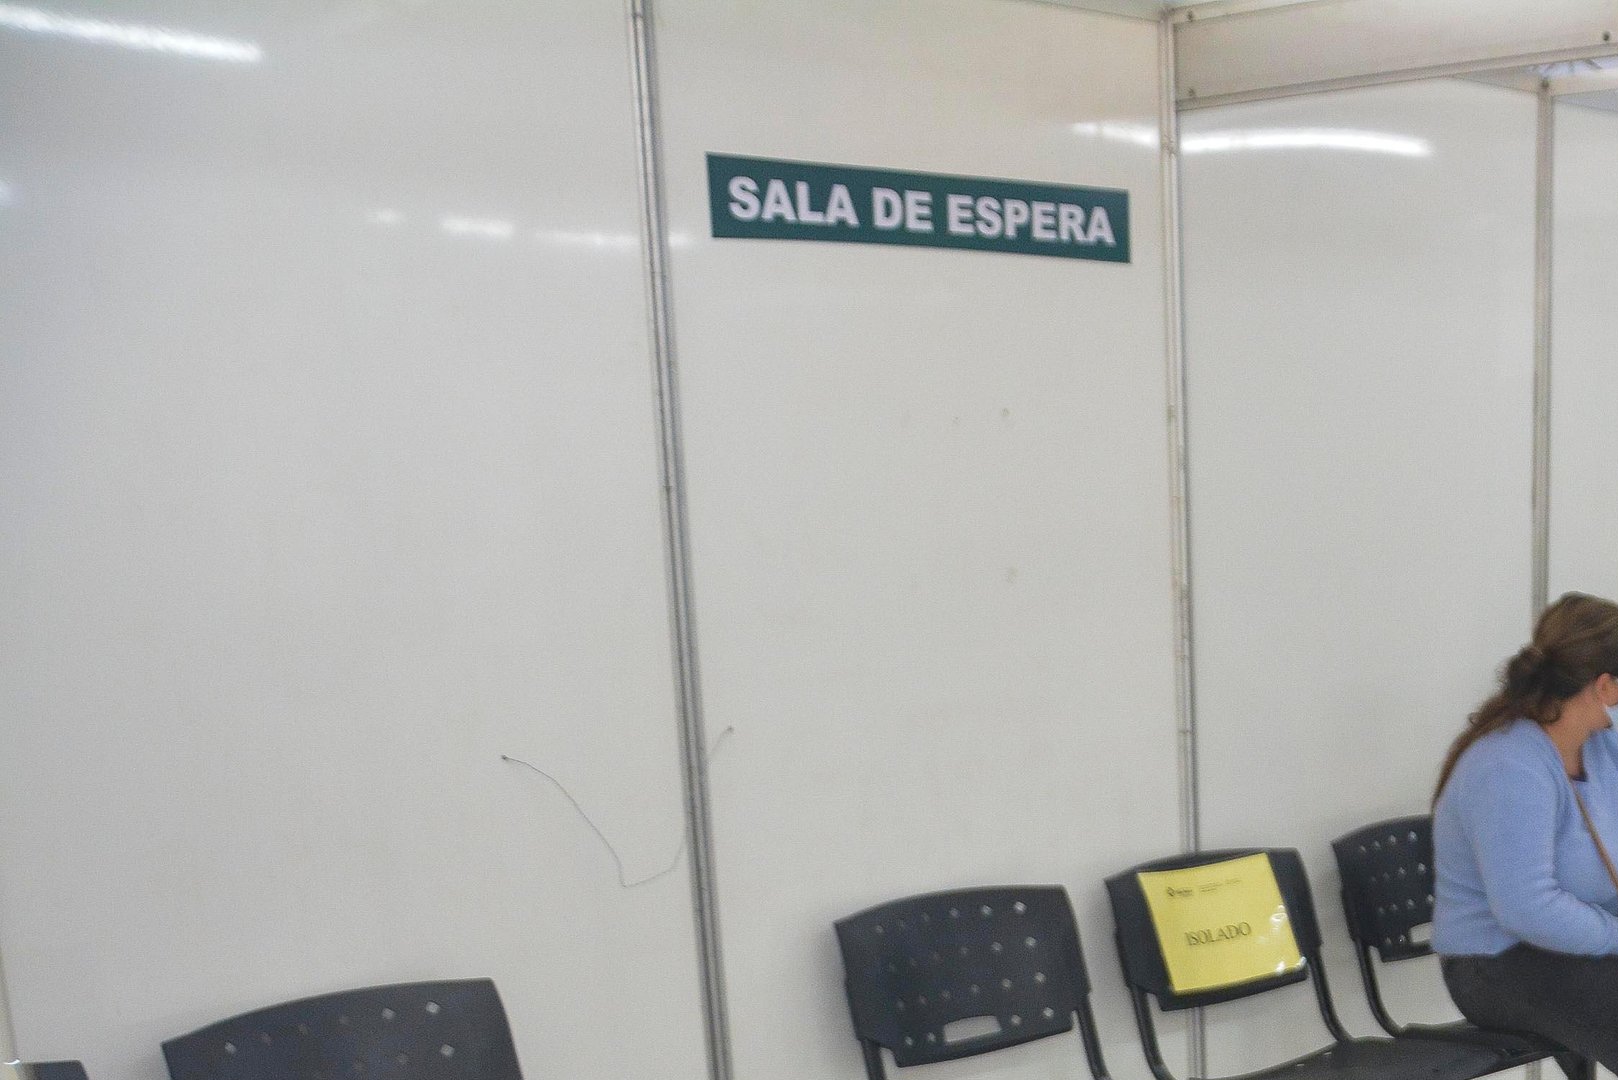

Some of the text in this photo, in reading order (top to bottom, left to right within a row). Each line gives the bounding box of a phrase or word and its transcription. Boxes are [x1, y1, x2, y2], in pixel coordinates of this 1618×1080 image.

[728, 175, 1117, 247] SALA DE ESPERA
[1184, 921, 1252, 946] ISOLADO
